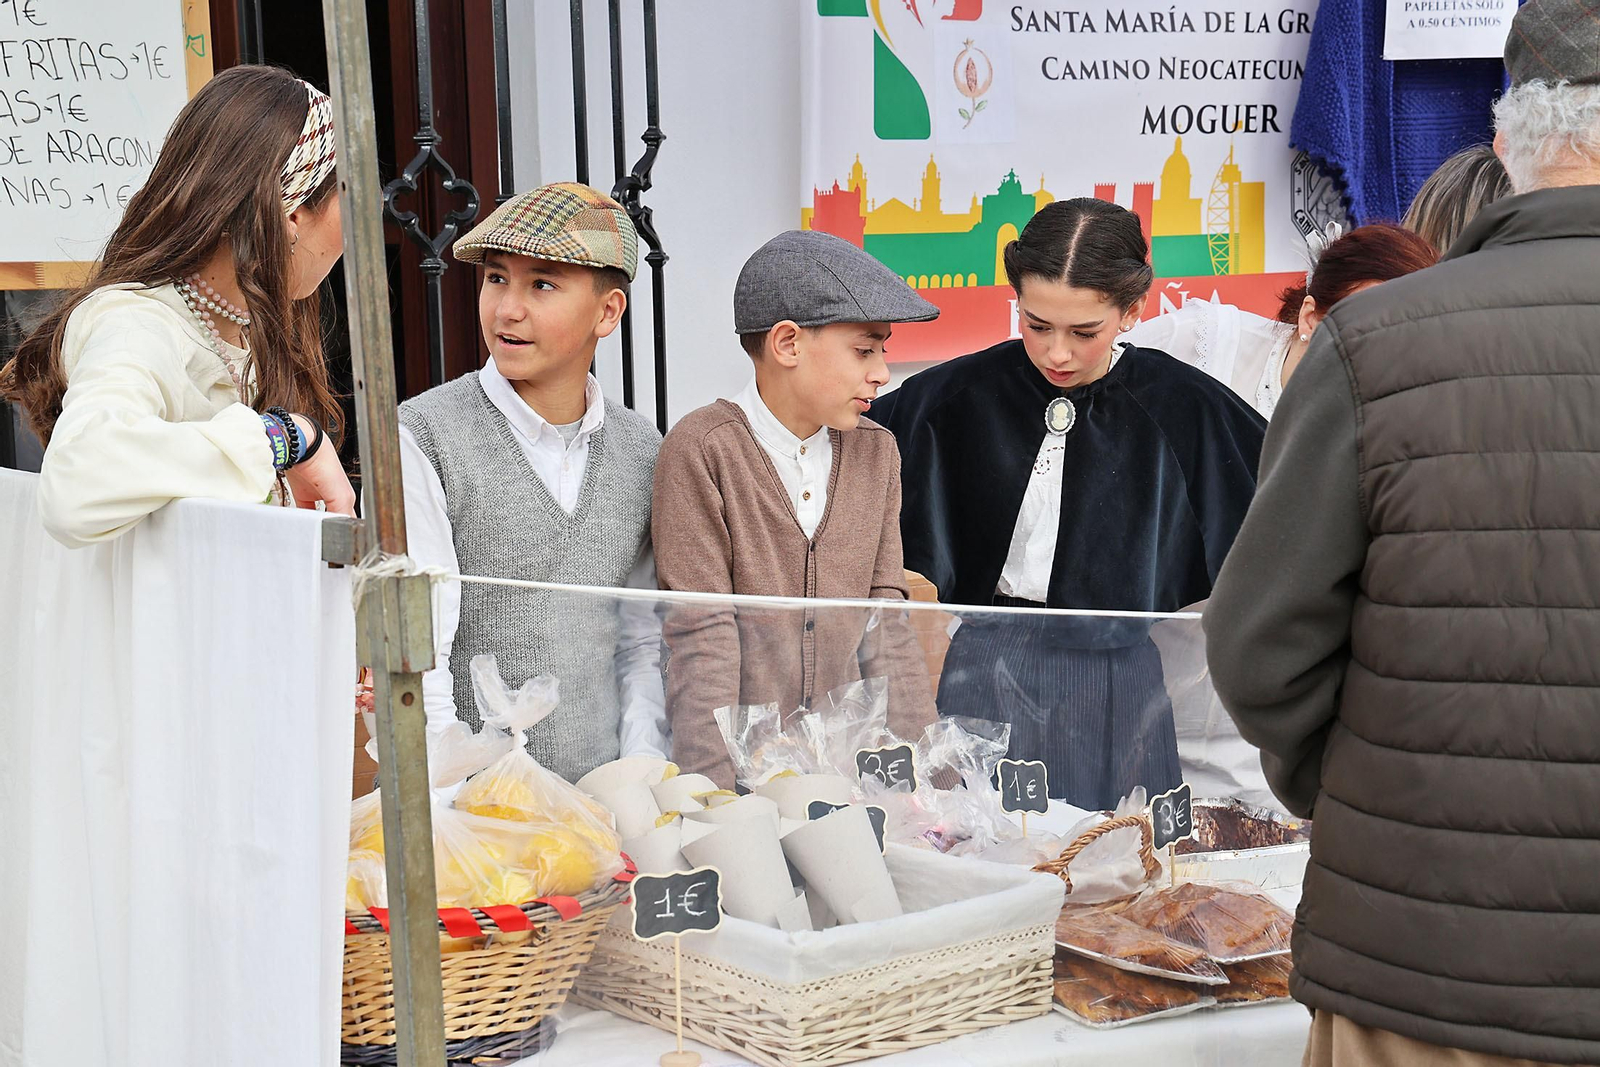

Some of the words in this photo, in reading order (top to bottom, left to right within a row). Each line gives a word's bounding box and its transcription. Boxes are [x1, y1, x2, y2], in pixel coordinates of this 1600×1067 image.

[1010, 5, 1097, 33] SANTA
[1105, 5, 1196, 33] MARÍA
[1204, 11, 1236, 33] DE
[1244, 11, 1271, 34] LA
[1404, 1, 1473, 12] PAPELETAS
[1475, 0, 1504, 10] SOLO
[1407, 19, 1415, 28] A
[1418, 17, 1439, 28] 0.50
[1442, 14, 1501, 27] CÉNTIMOS
[0, 38, 129, 82] FRITAS
[136, 42, 171, 80] 1€
[1041, 56, 1150, 80] CAMINO
[46, 93, 89, 123] 1€
[1140, 104, 1282, 135] MOGUER
[47, 129, 153, 168] ARAGON
[1009, 771, 1037, 801] 1€
[653, 882, 707, 918] 1€
